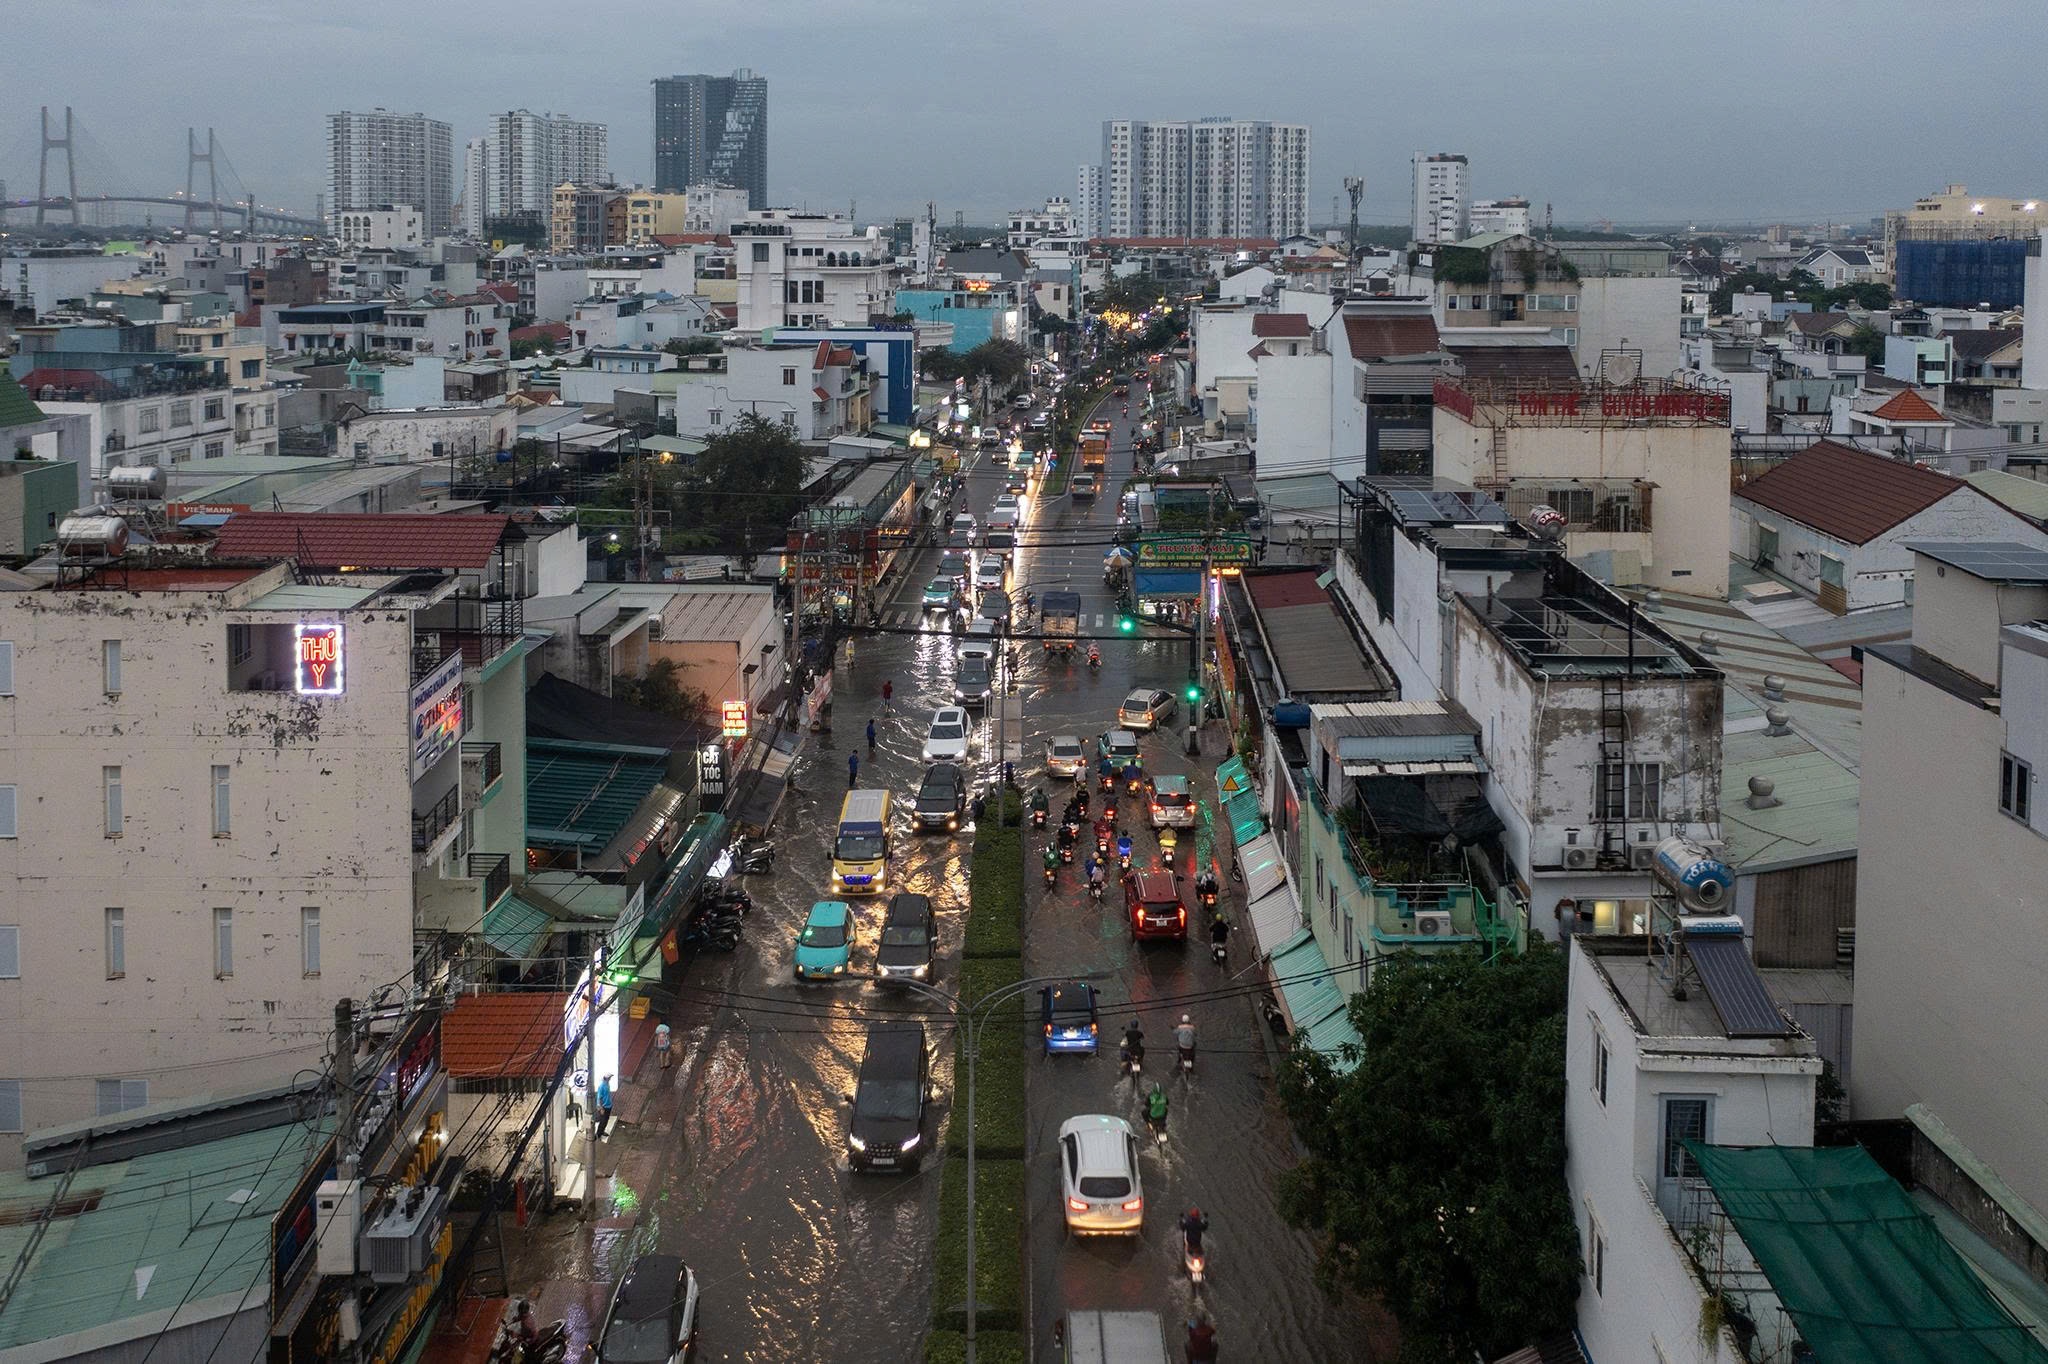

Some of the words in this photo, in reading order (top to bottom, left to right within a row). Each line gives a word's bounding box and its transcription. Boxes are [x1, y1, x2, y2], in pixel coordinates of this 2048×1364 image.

[301, 631, 337, 660] THÚ
[312, 664, 326, 687] Y
[703, 765, 721, 779] TÓC
[702, 782, 723, 794] NAM
